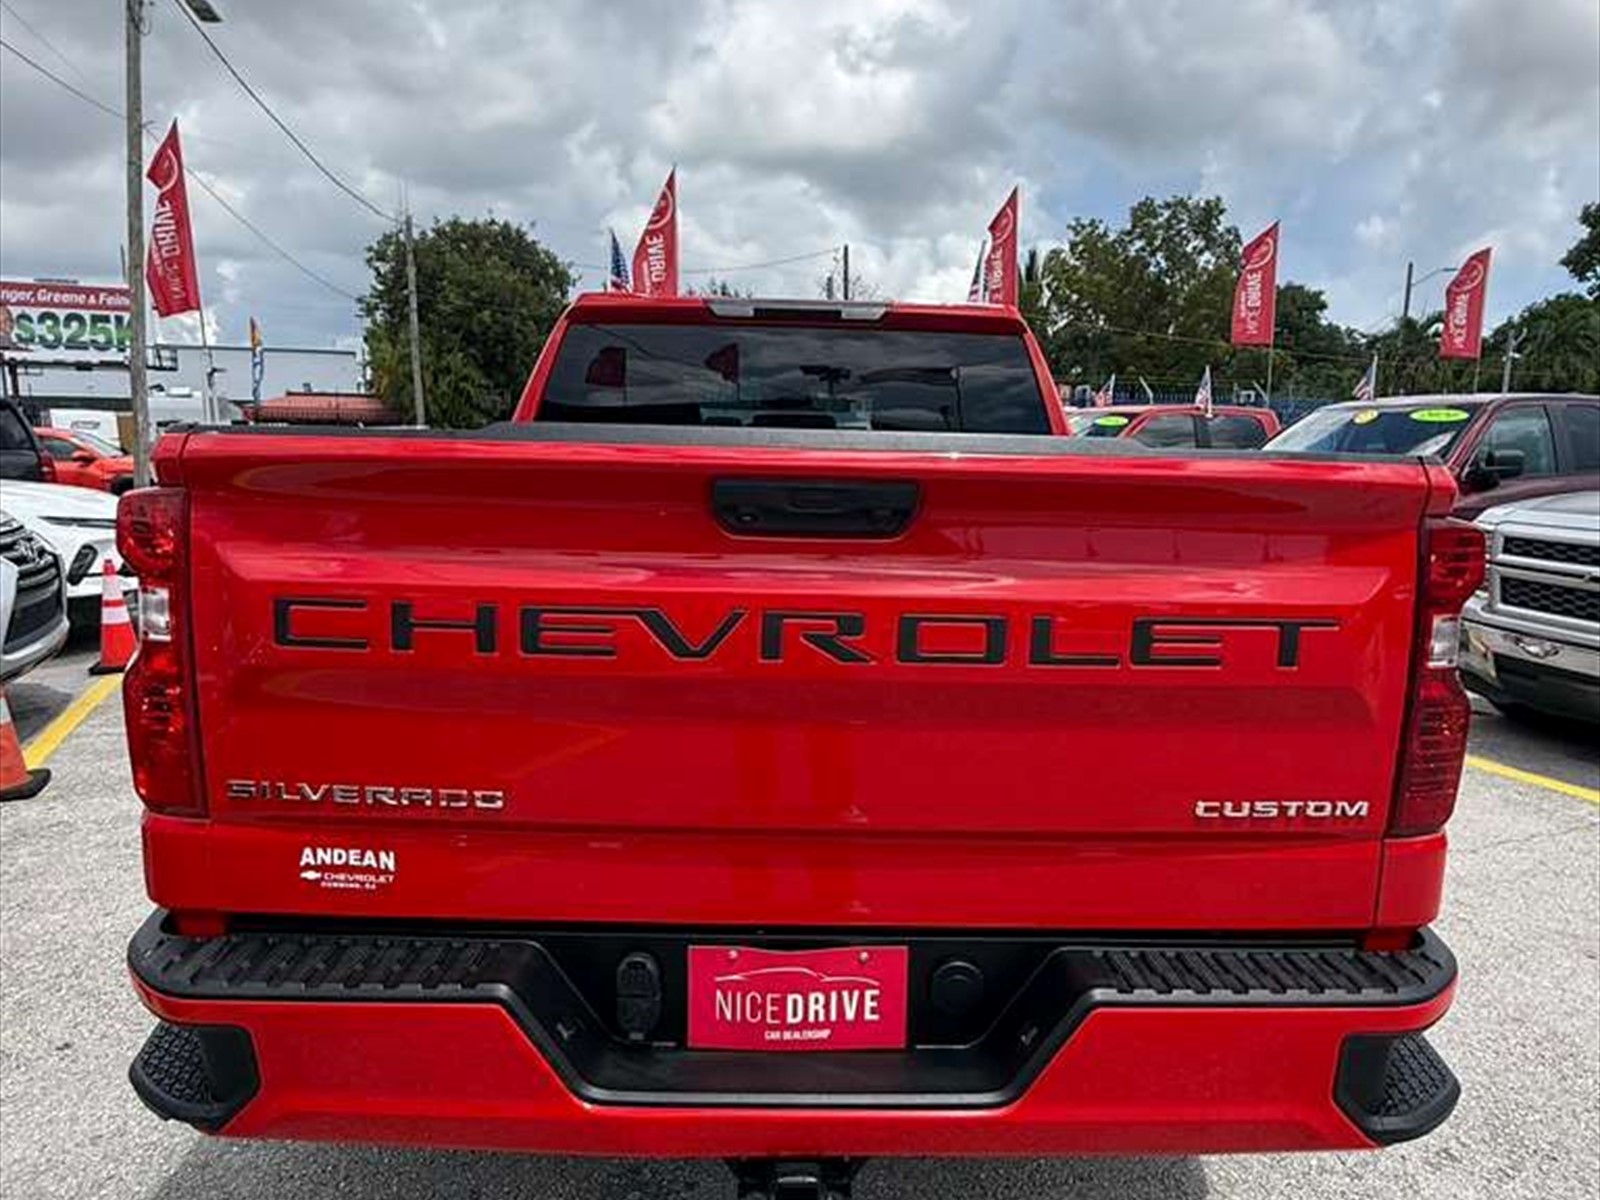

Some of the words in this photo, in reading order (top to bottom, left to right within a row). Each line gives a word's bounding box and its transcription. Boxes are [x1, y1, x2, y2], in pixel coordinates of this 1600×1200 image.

[37, 289, 86, 305] Greene
[272, 597, 1341, 671] CHEVROLET
[226, 779, 505, 809] SILVERADO
[1195, 801, 1370, 818] CUSTOM
[300, 847, 395, 872] ANDEAN
[323, 872, 395, 884] CHEVROLET
